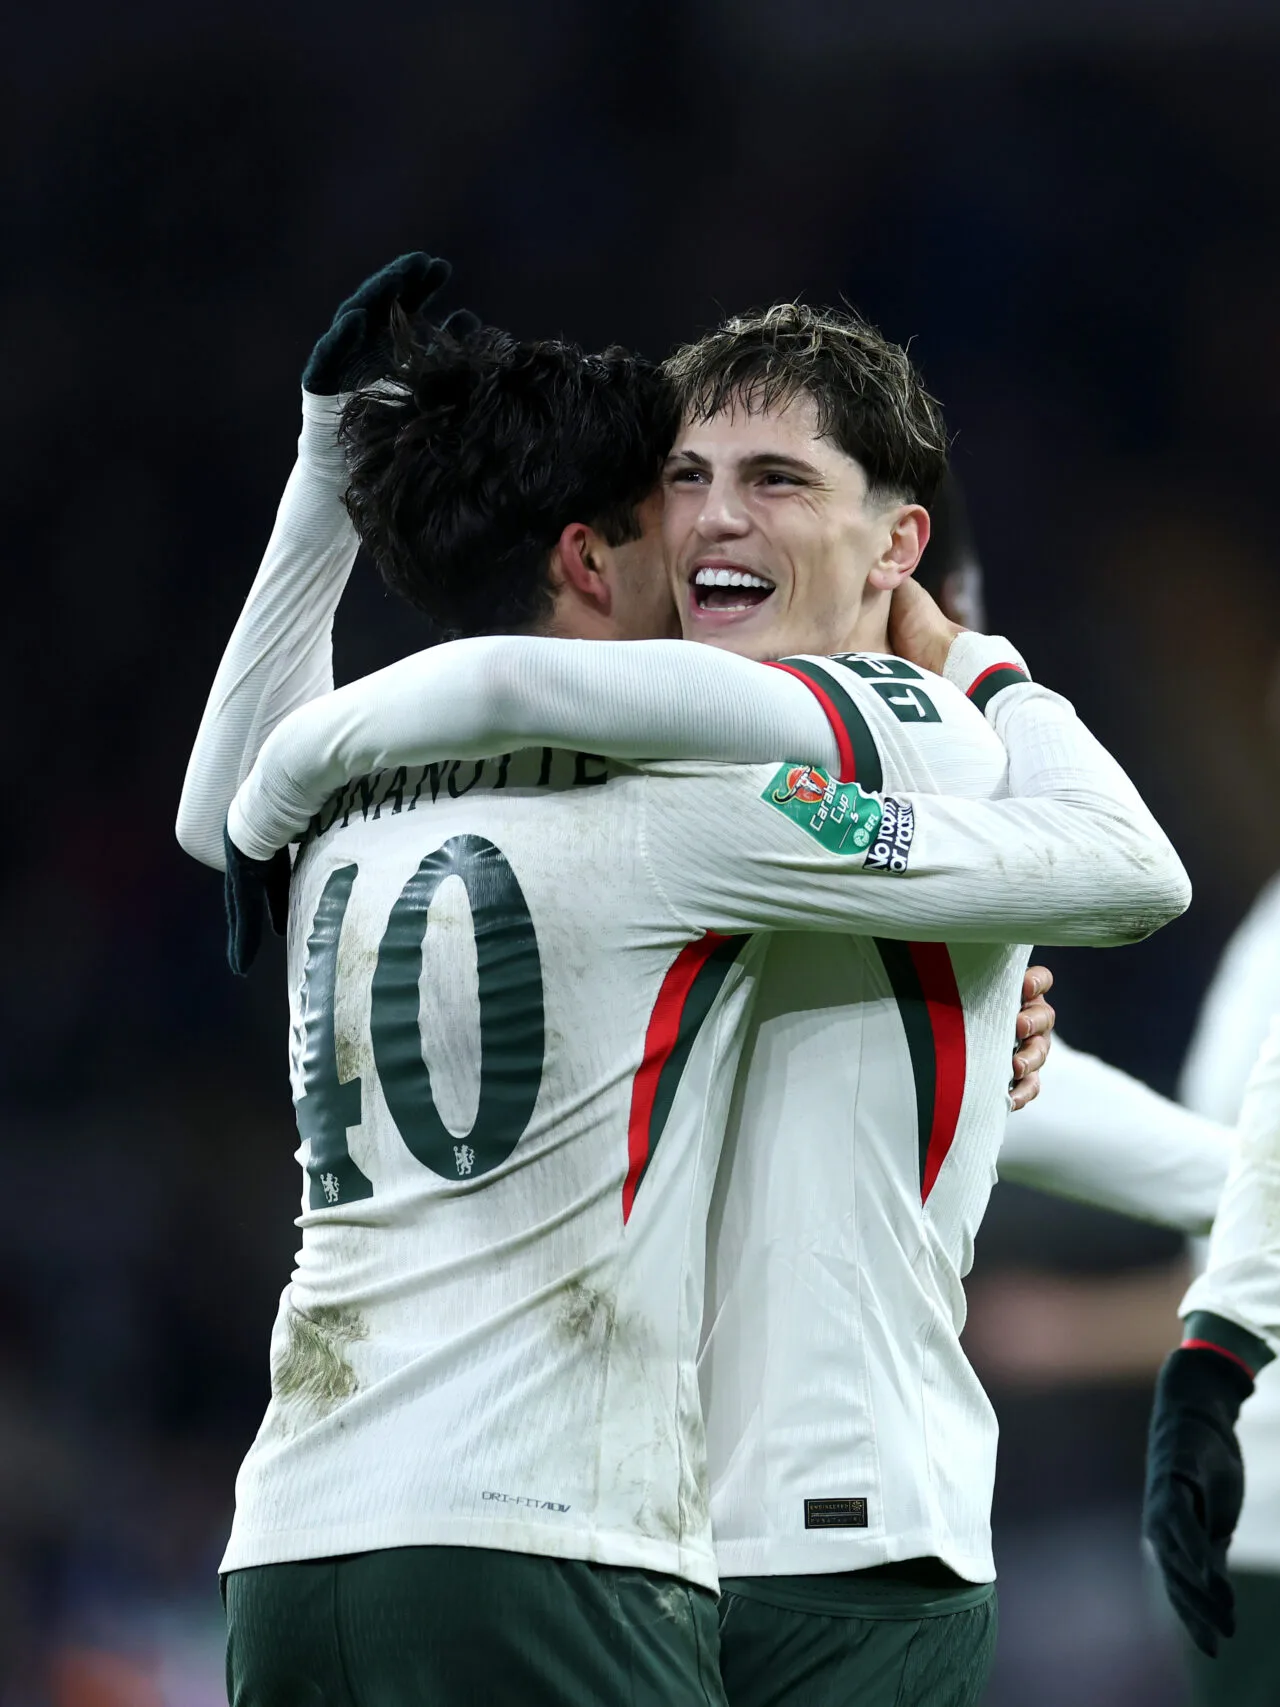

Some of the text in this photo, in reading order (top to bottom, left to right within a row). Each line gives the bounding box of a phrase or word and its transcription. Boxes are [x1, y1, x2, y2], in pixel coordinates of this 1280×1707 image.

[830, 794, 849, 824] Cup
[865, 813, 880, 832] EFL
[865, 843, 891, 872] No
[296, 834, 545, 1211] 40
